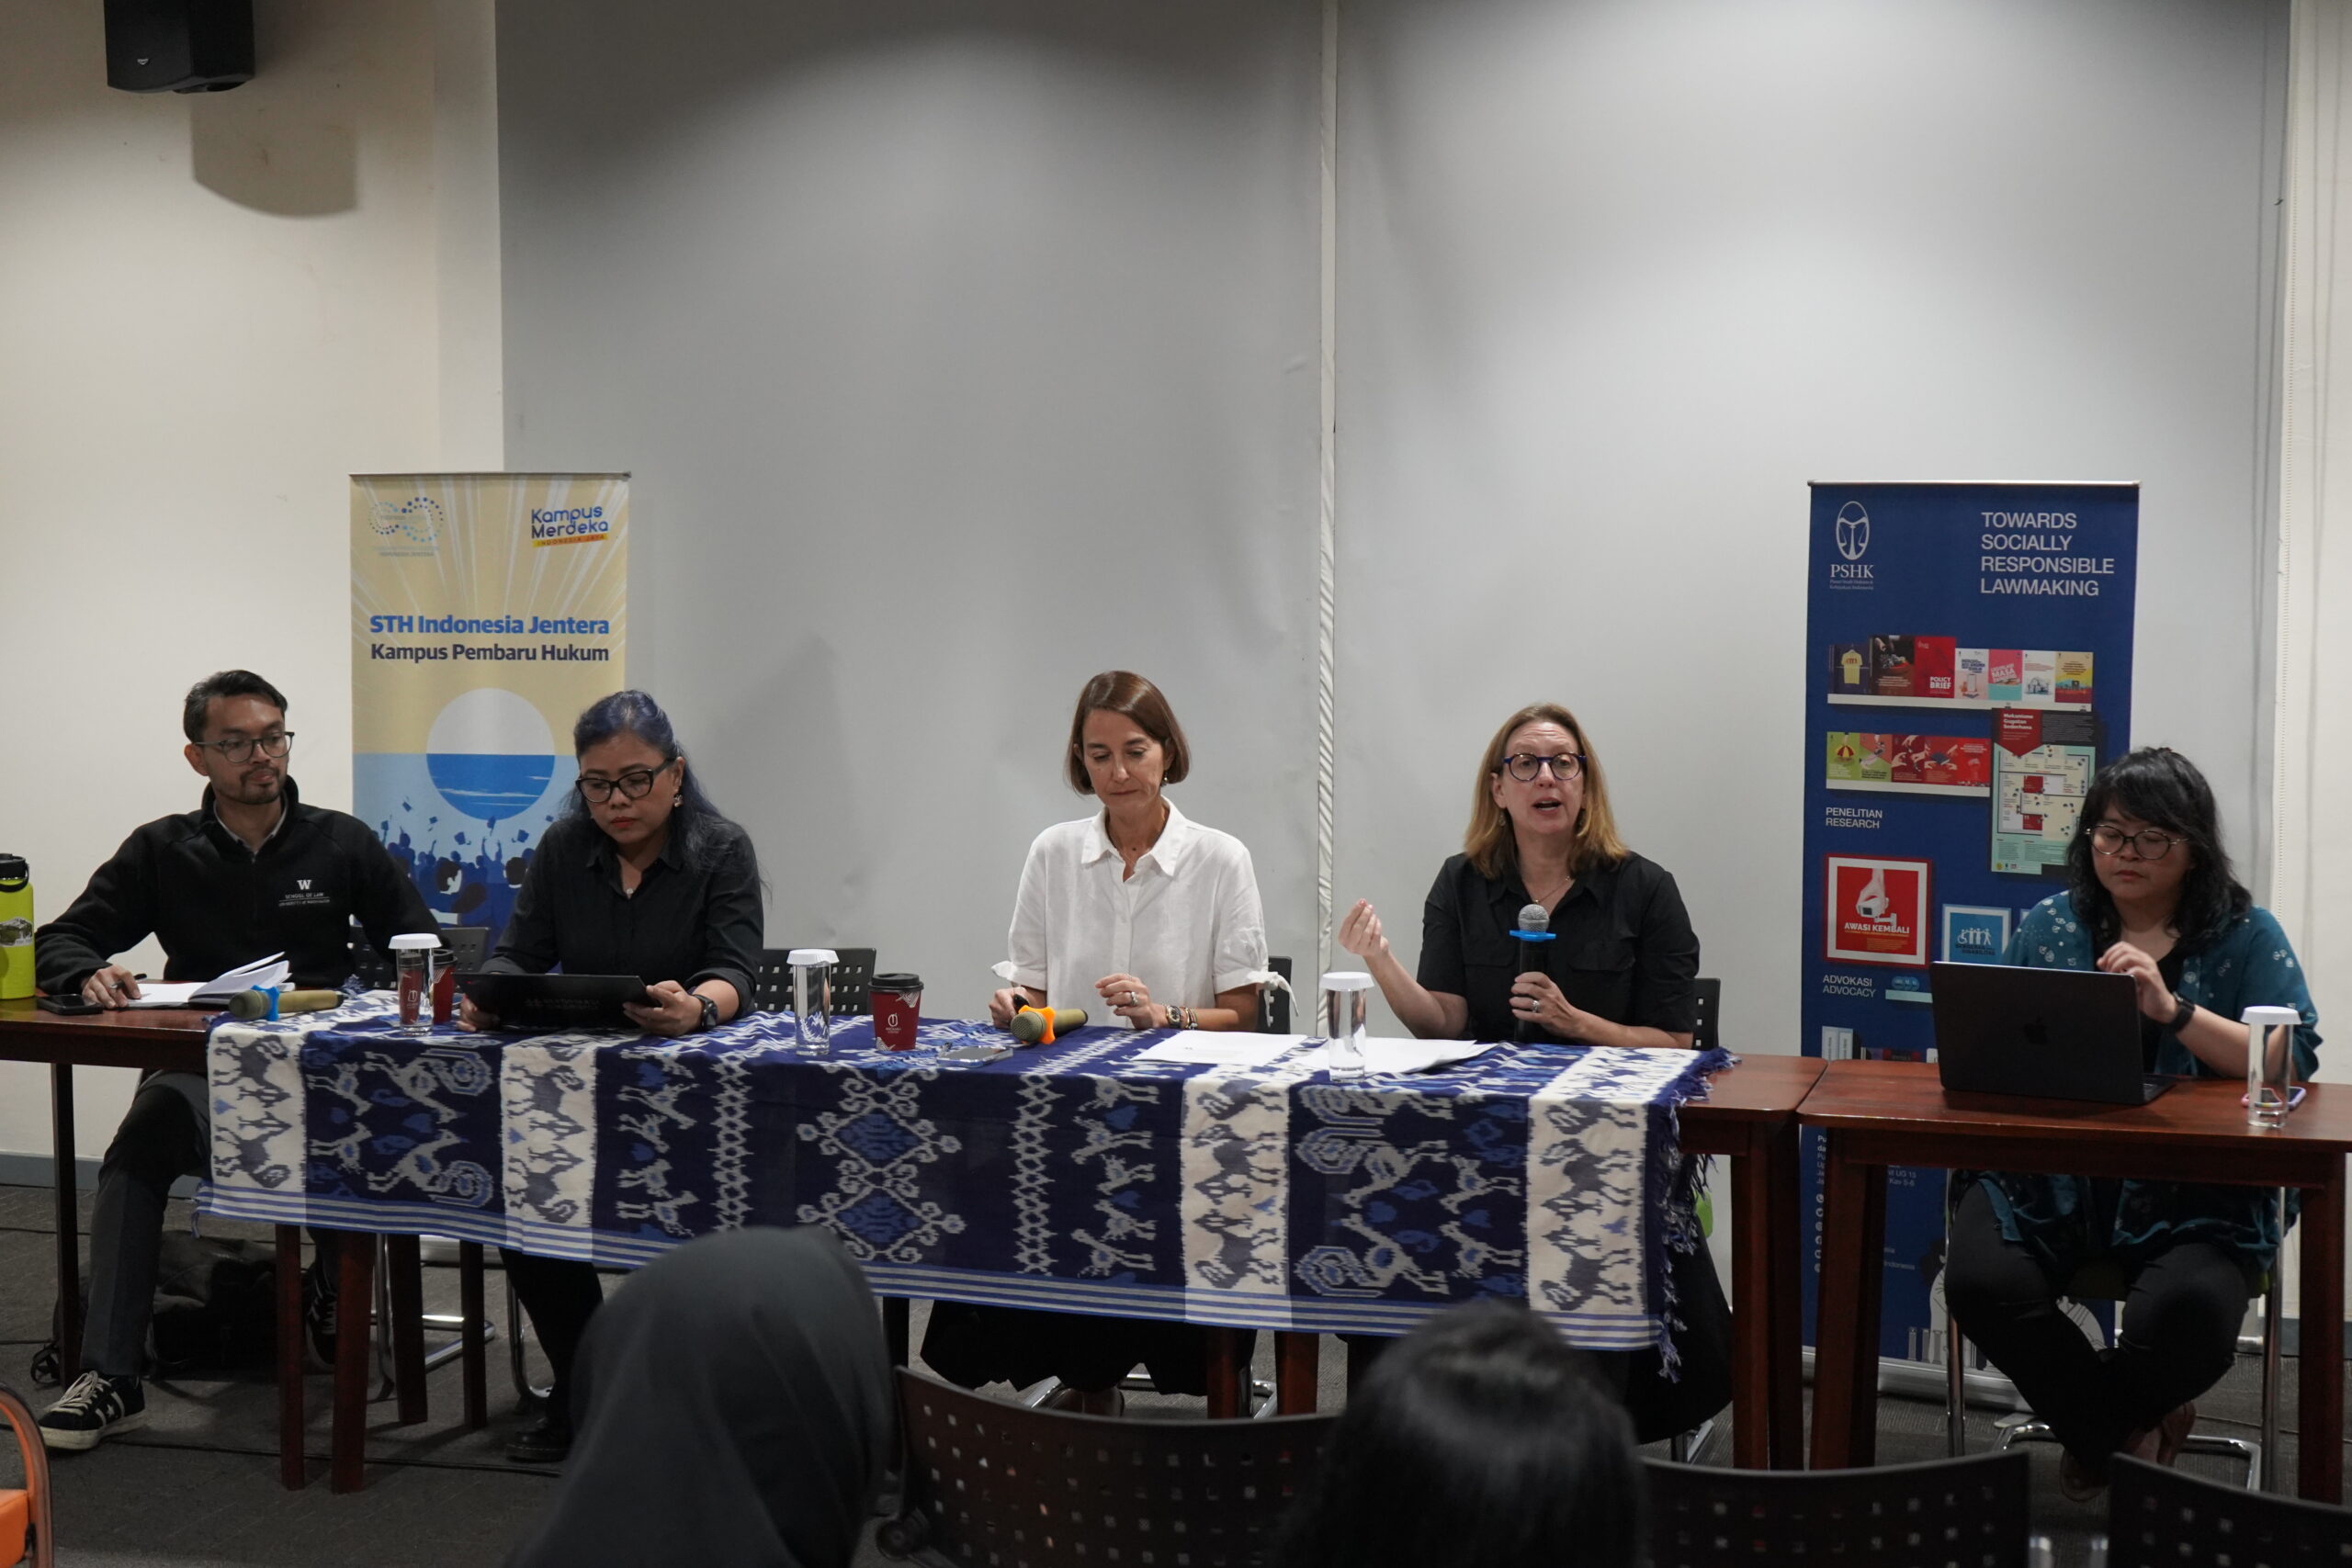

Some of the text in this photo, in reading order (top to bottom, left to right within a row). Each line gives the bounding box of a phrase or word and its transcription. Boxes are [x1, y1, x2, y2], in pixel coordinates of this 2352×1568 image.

[532, 506, 603, 524] Kampus
[1981, 512, 2077, 529] TOWARDS
[532, 519, 608, 539] Merdeka
[1981, 534, 2073, 551] SOCIALLY
[1830, 564, 1874, 579] PSHK
[1981, 556, 2115, 574] RESPONSIBLE
[1980, 578, 2099, 596] LAWMAKING
[370, 615, 609, 634] STH Indonesia Jentera
[371, 643, 609, 663] Kampus Pembaru Hukum
[1929, 682, 1951, 690] BRIEF
[1826, 807, 1883, 818] PENELITIAN
[1826, 818, 1880, 829] RESEARCH
[297, 879, 311, 890] W
[1844, 922, 1871, 931] AWASI
[1872, 924, 1910, 934] KEMBALI
[1823, 975, 1872, 987] ADVOKASI
[1823, 985, 1876, 998] ADVOCACY
